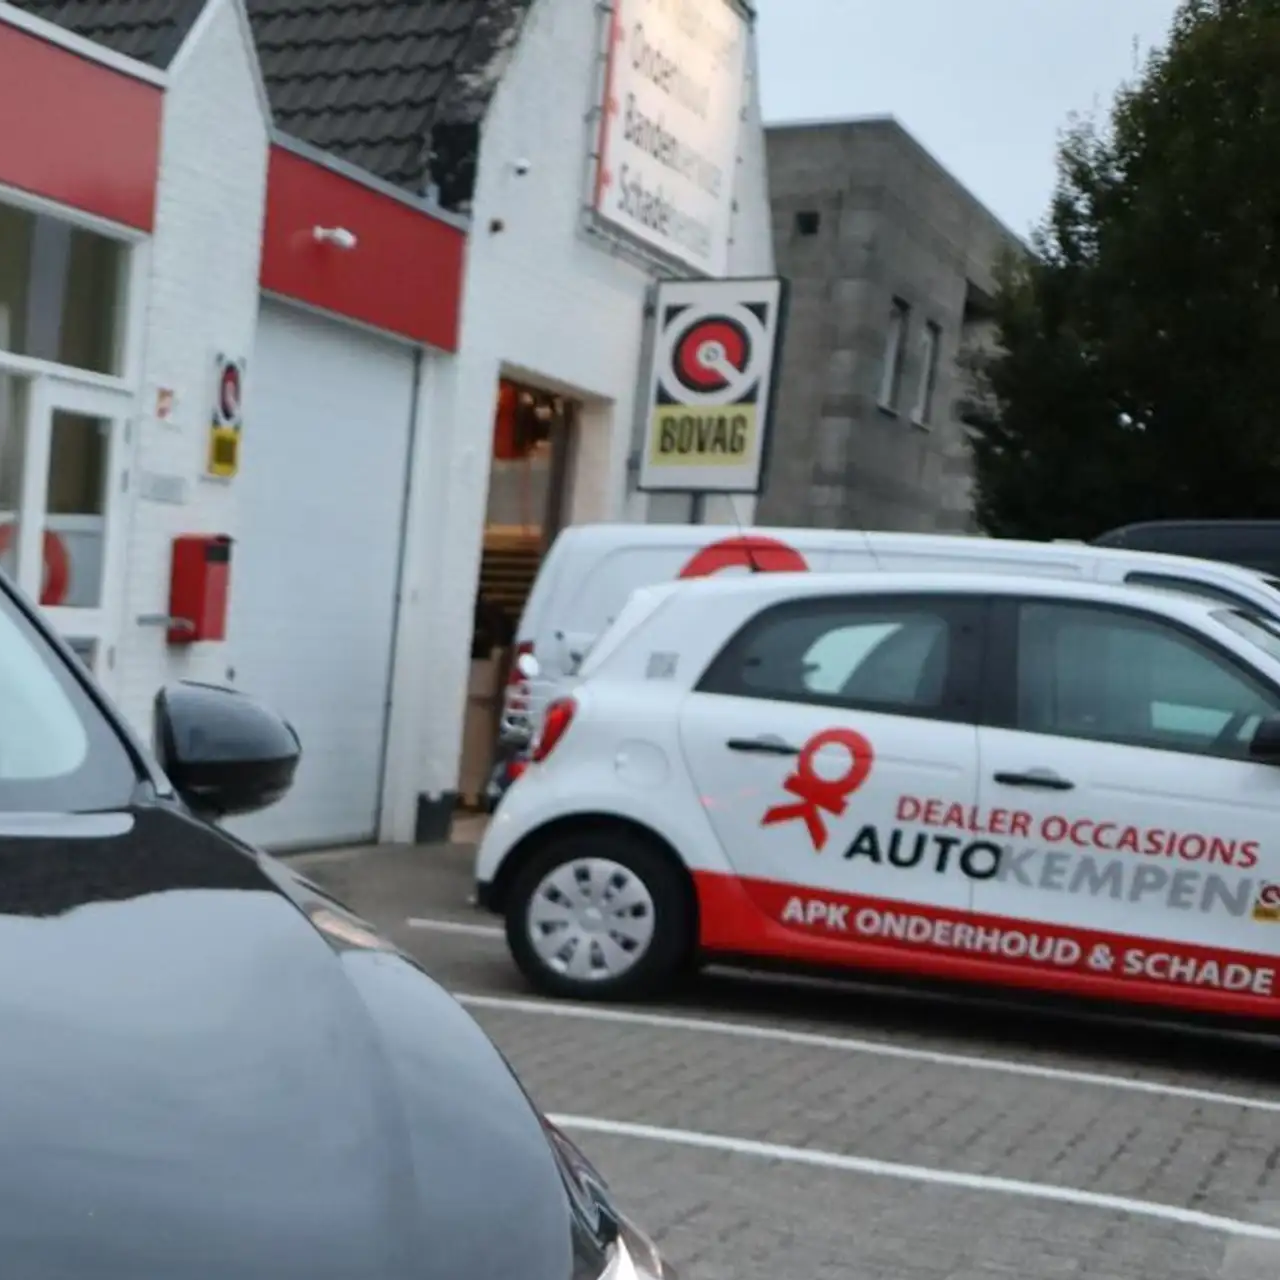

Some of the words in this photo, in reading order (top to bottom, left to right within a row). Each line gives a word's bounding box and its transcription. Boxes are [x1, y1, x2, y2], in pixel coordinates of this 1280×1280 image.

[659, 413, 747, 454] BOVAG
[895, 795, 1033, 838] DEALER
[1040, 815, 1261, 869] OCCASIONS
[782, 896, 850, 932] APK
[855, 908, 1081, 966] ONDERHOUD
[1088, 943, 1115, 971] &
[1123, 948, 1275, 995] SCHADE
